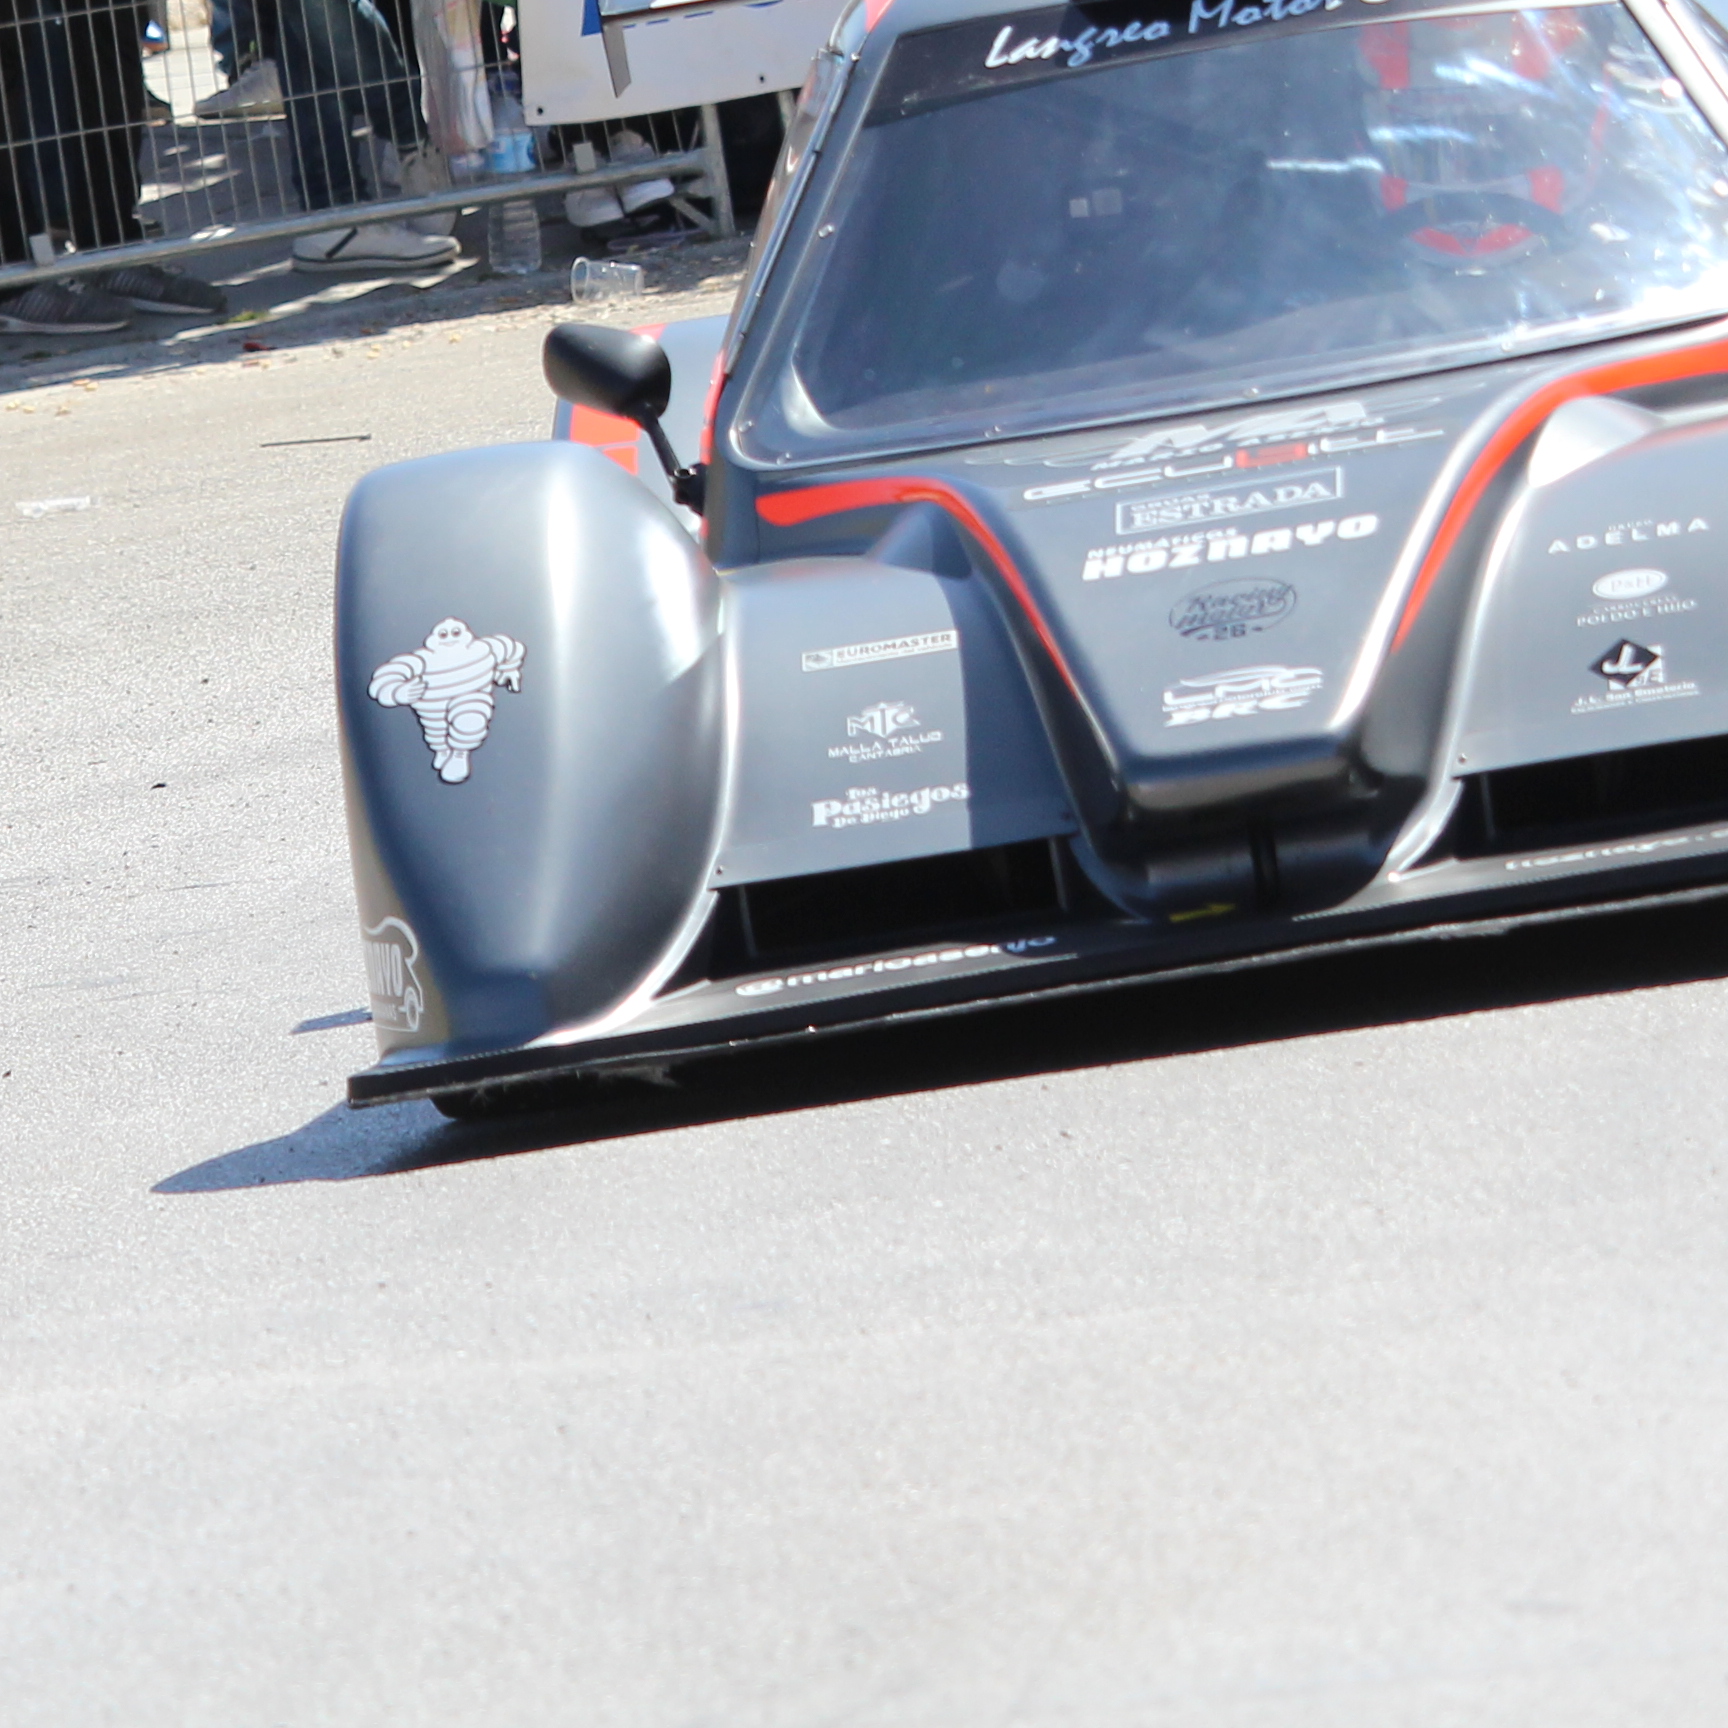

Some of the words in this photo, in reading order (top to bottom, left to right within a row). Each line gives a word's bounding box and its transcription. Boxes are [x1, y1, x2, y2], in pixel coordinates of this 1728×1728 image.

[985, 21, 1170, 68] Langreo
[1129, 481, 1333, 529] ESTRADA
[1081, 513, 1380, 582] HOZNAYO
[1547, 517, 1710, 555] ADELMA
[836, 632, 953, 658] EUROMASTER
[828, 740, 882, 758] MALLA
[810, 782, 971, 827] Pasiegos
